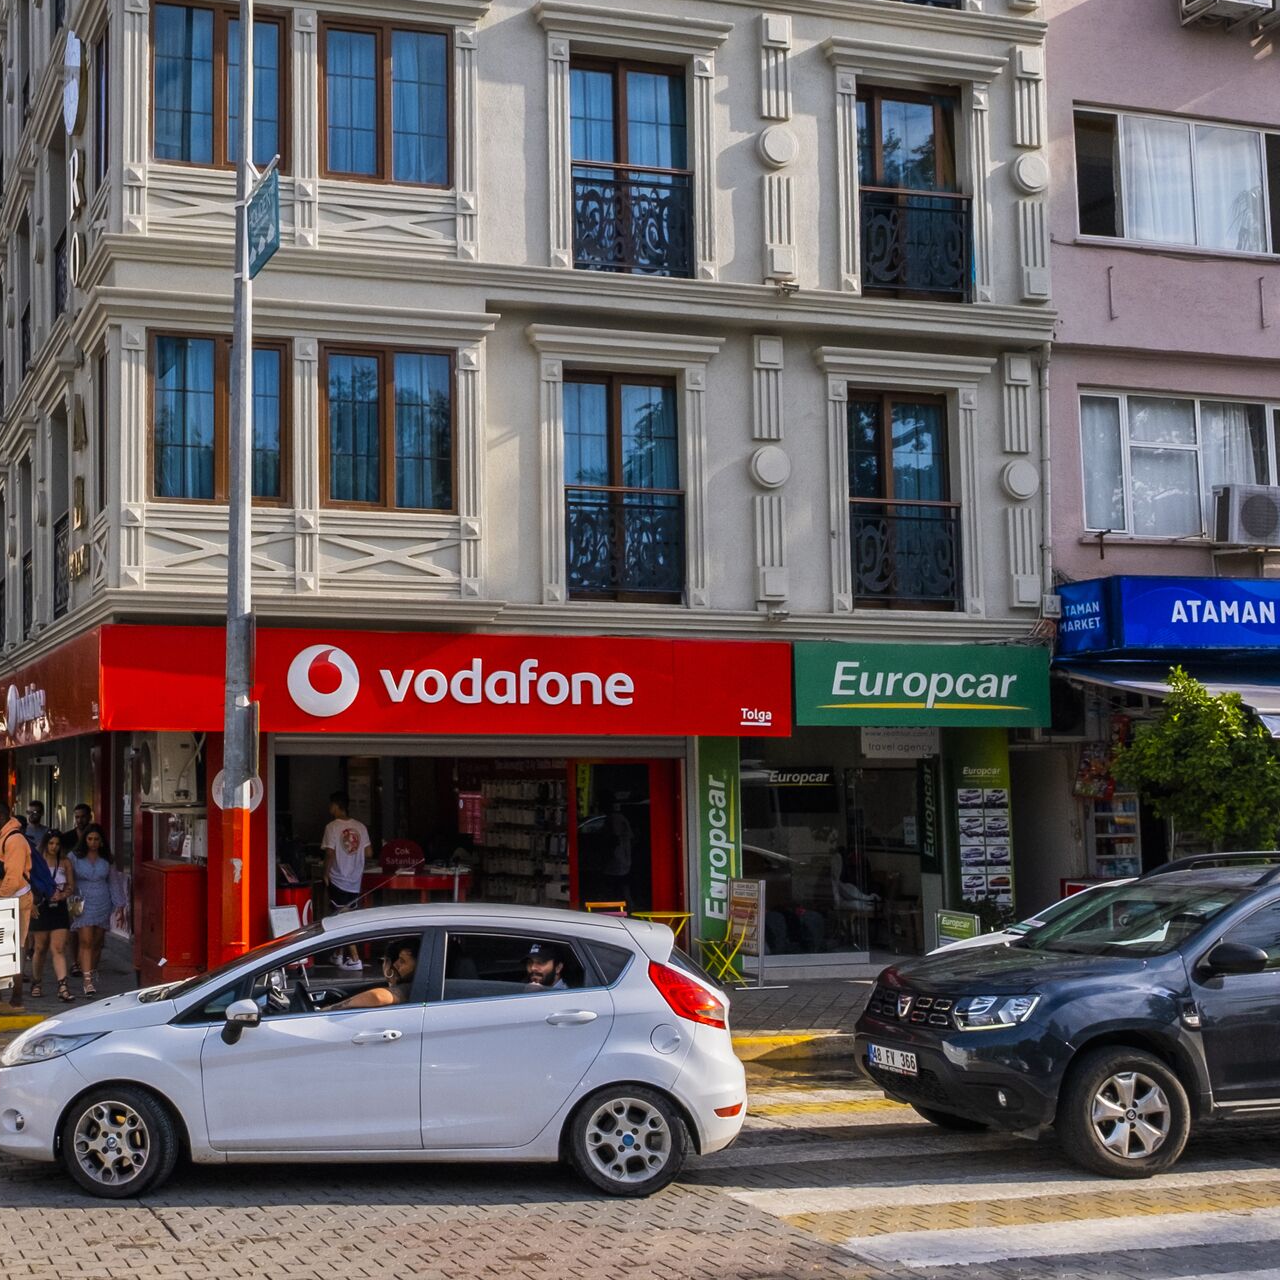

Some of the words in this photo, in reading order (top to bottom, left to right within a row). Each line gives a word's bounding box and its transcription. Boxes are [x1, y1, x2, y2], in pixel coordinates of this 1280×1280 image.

[1063, 601, 1100, 617] TAMAN
[1171, 599, 1276, 625] ATAMAN
[379, 657, 634, 706] vodafone
[831, 661, 1017, 709] Europcar
[740, 707, 772, 724] Tolga
[869, 743, 894, 751] travel
[897, 743, 933, 752] agency
[769, 770, 830, 786] Europcar
[962, 766, 1001, 777] Europcar
[923, 764, 936, 858] Europcar
[705, 774, 735, 921] Europcar
[941, 916, 970, 931] Europcar
[873, 1047, 882, 1062] 48
[886, 1050, 895, 1066] FV
[900, 1053, 915, 1070] 366
